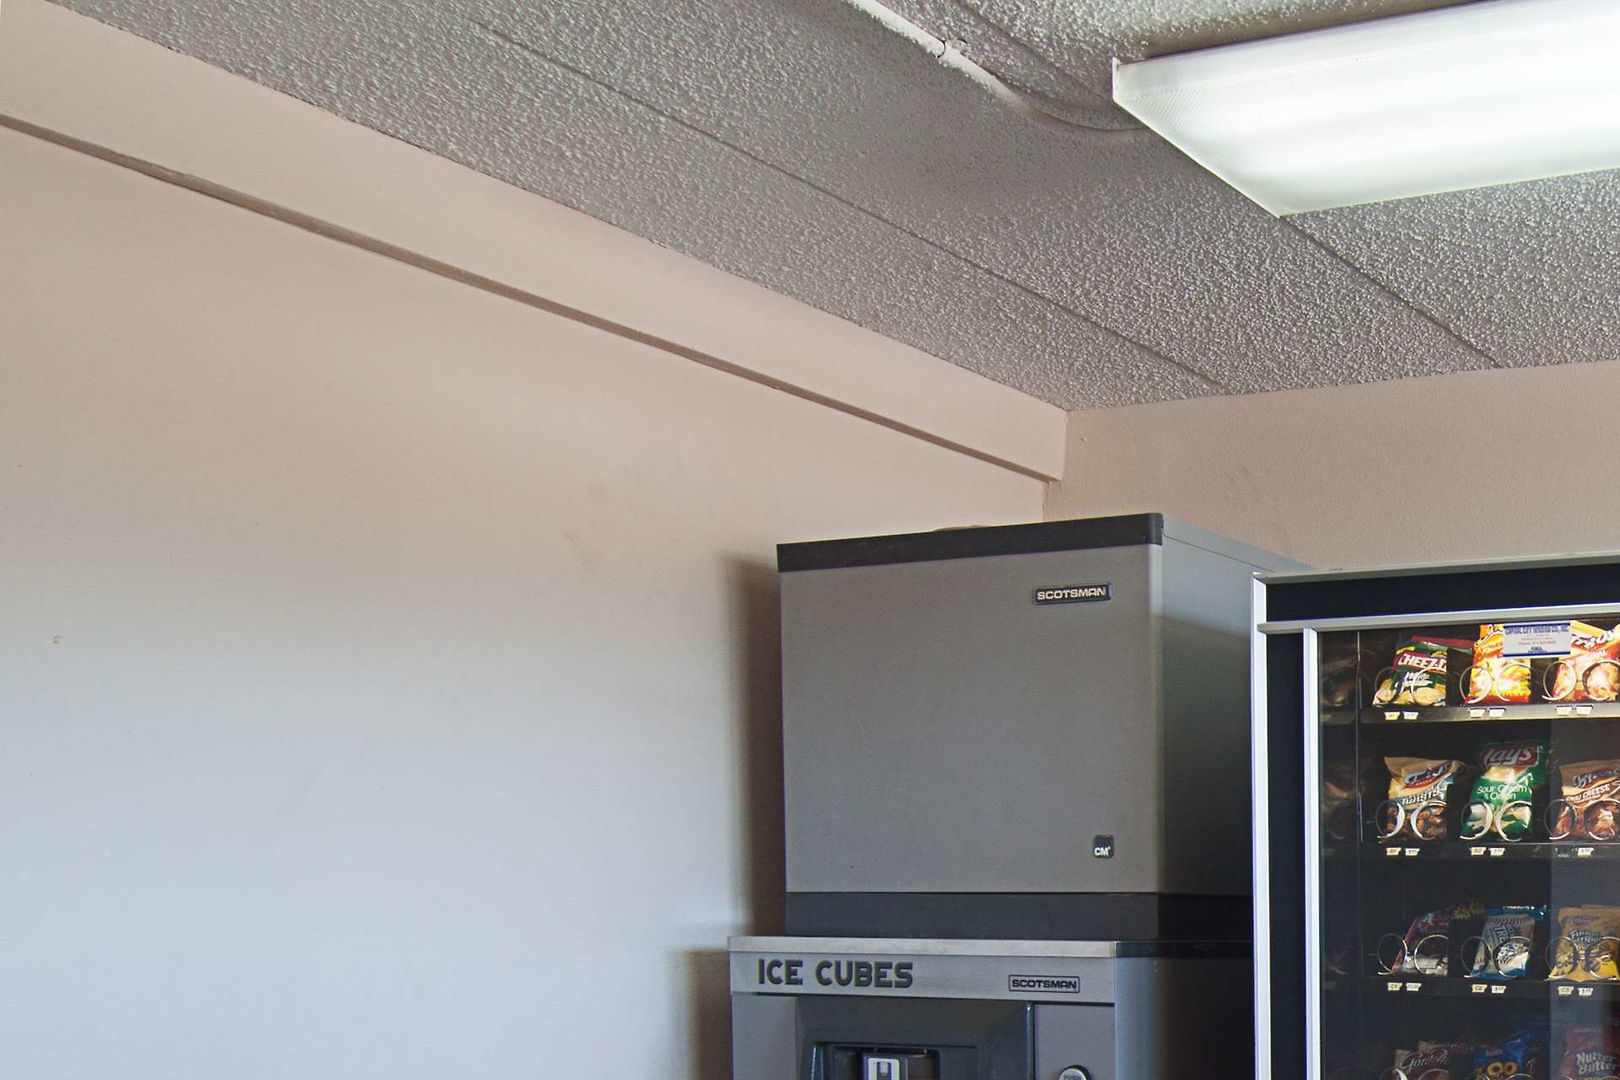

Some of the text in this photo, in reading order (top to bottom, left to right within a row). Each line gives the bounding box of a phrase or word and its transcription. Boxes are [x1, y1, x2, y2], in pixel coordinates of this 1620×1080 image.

[1036, 585, 1108, 601] SCOTSMAN
[1477, 785, 1495, 794] Sour
[757, 959, 914, 990] ICE CUBES
[1011, 976, 1078, 992] SCOTSMAN
[1576, 1051, 1617, 1064] Nutter
[1578, 1061, 1620, 1075] Butter
